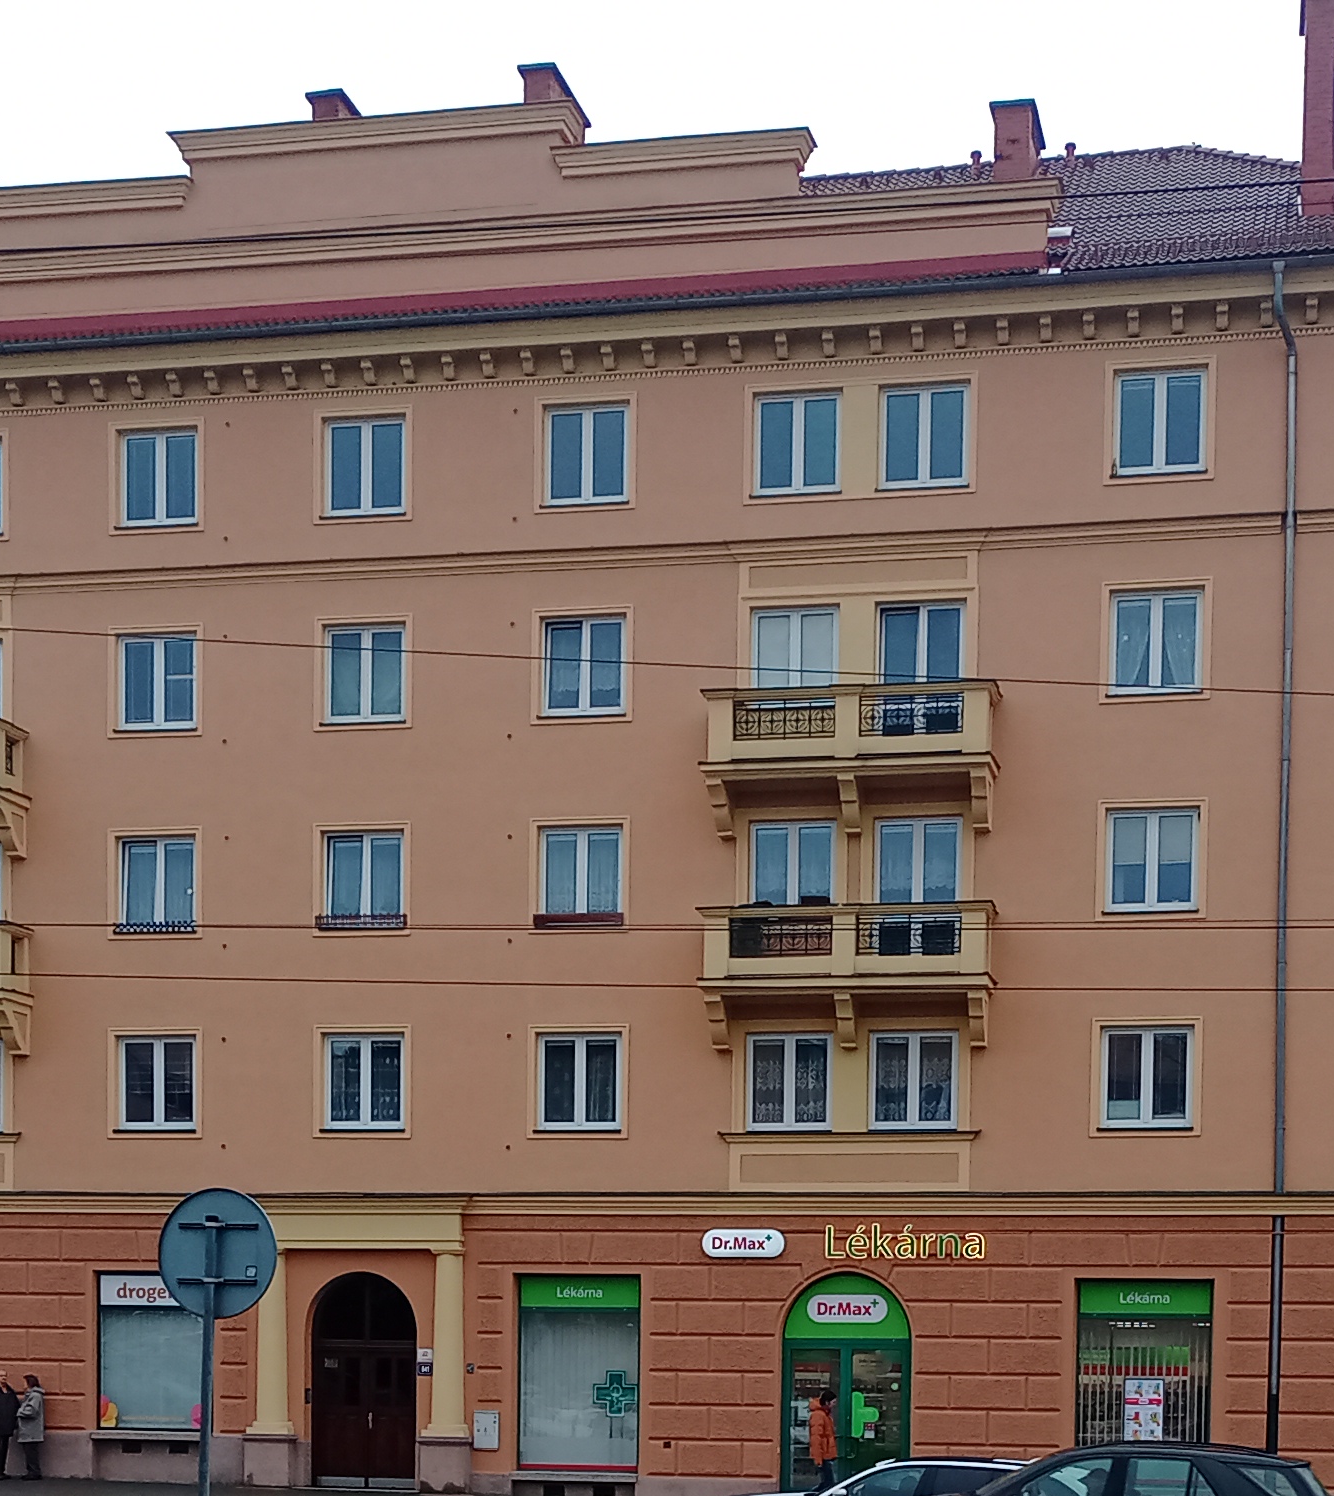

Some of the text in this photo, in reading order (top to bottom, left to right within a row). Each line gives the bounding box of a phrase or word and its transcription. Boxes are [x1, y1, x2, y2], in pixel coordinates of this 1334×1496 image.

[824, 1222, 986, 1259] Lékárna
[116, 1282, 172, 1303] droge
[556, 1285, 603, 1298] Lékárna
[1119, 1291, 1171, 1304] Lékárna
